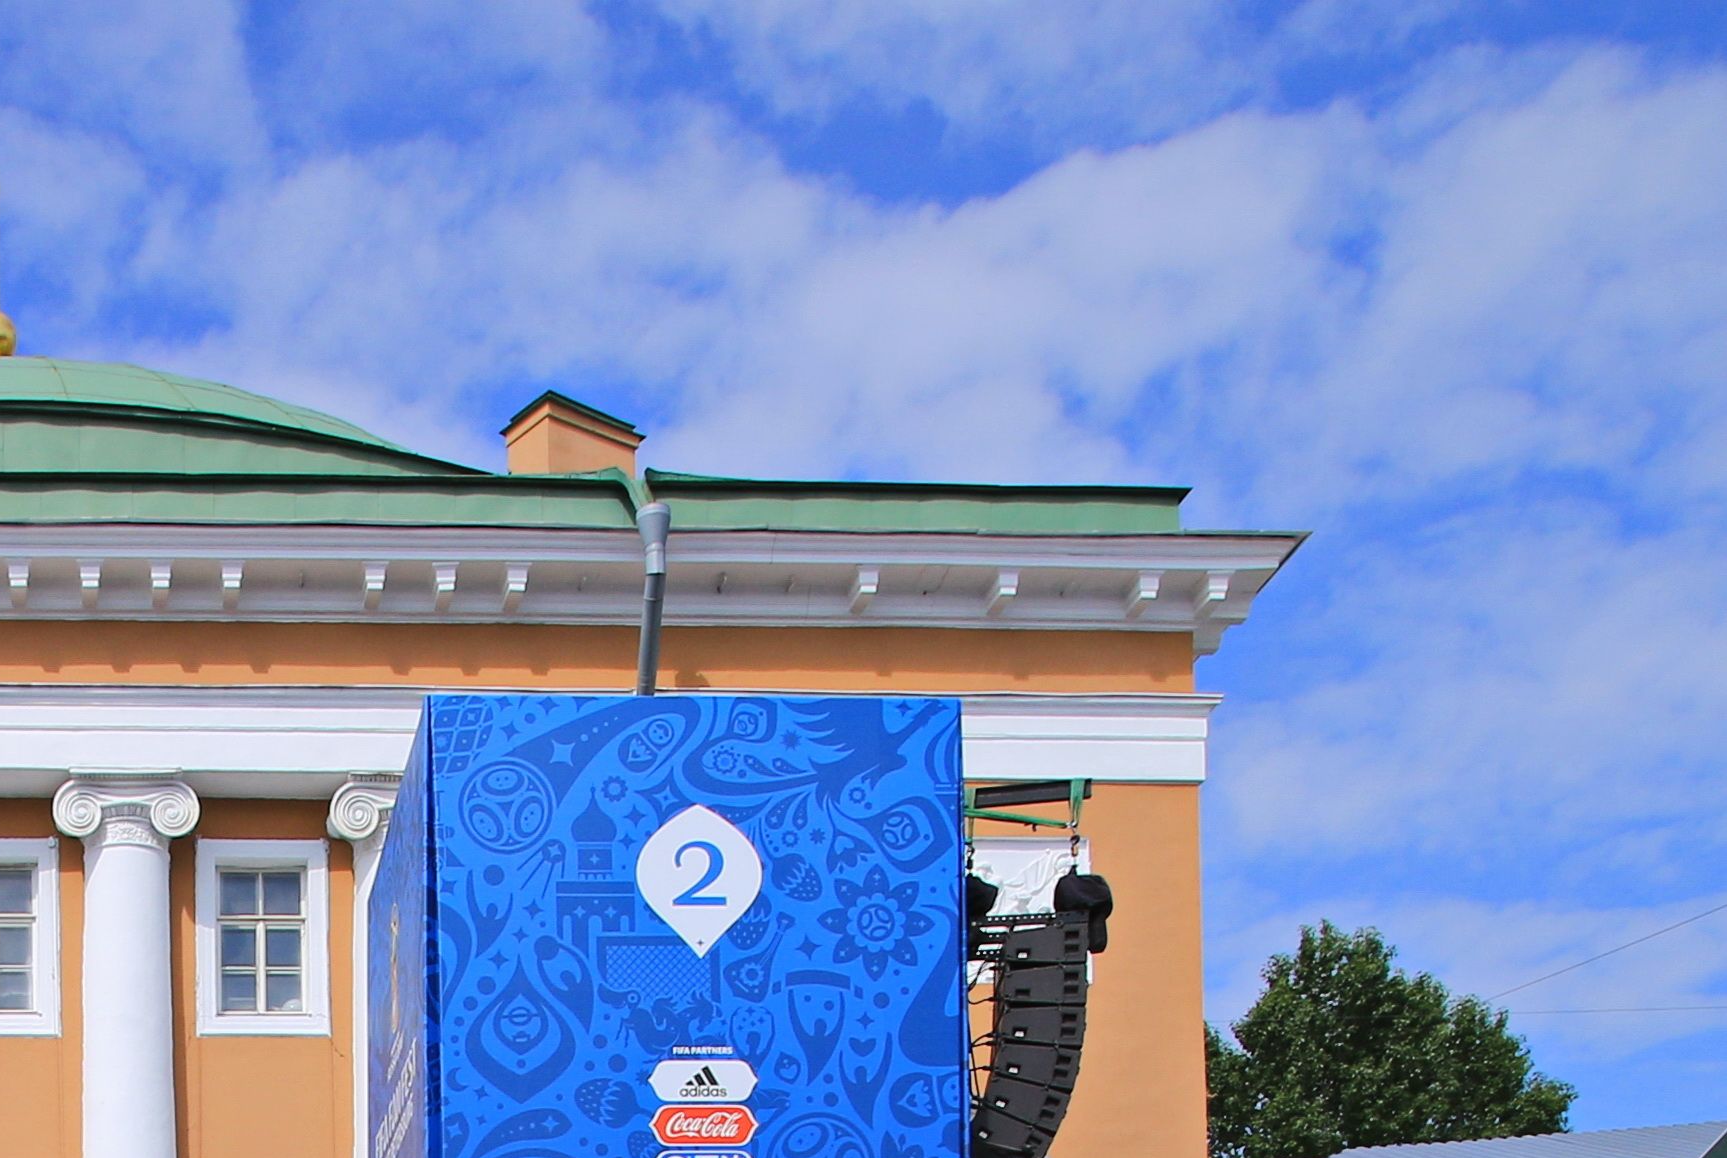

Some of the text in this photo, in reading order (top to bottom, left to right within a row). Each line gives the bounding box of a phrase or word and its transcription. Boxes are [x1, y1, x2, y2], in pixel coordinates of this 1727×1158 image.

[672, 841, 727, 906] 2
[672, 1046, 733, 1055] FIFA PARTNERS
[679, 1086, 727, 1098] adidas
[665, 1111, 743, 1138] Coca-Cola
